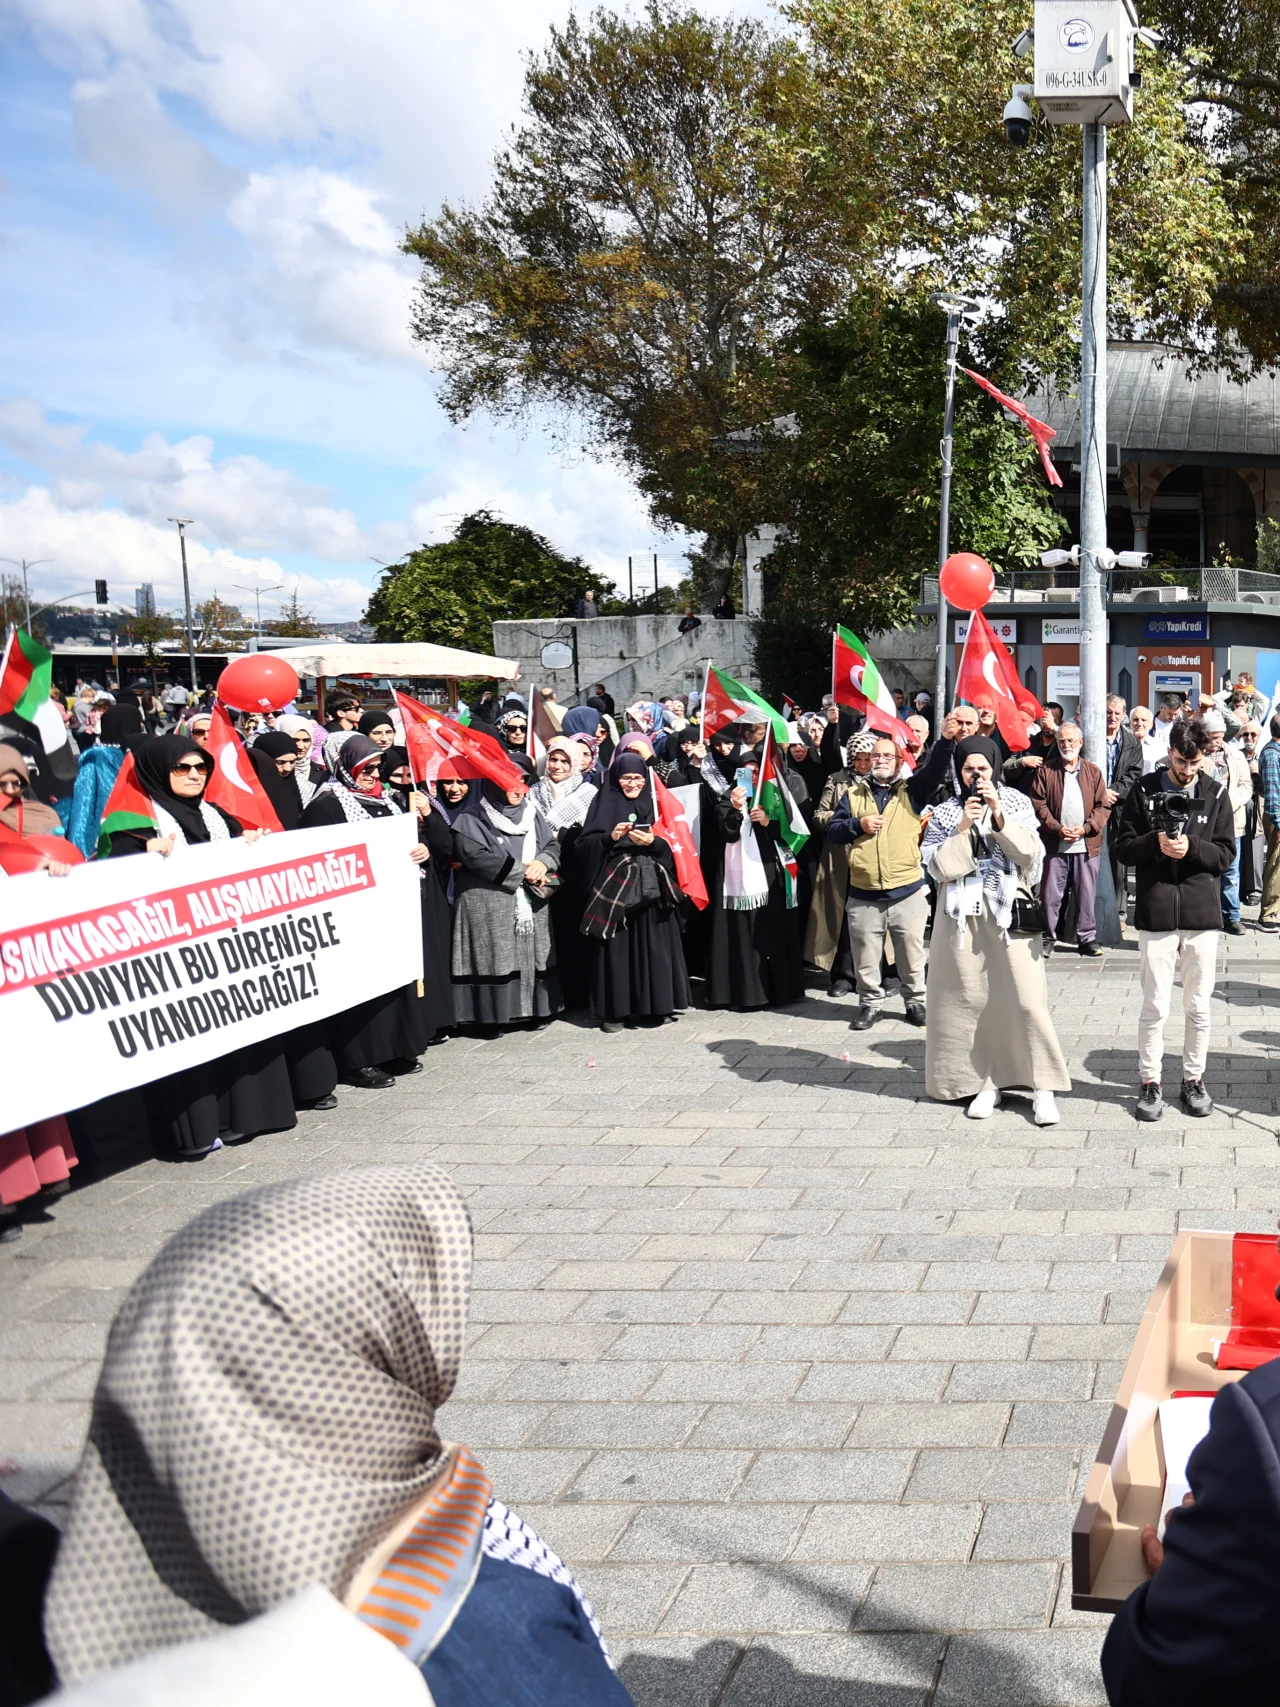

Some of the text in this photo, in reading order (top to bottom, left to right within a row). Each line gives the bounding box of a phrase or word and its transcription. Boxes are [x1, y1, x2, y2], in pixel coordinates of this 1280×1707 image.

[1045, 71, 1107, 88] 096-G-34USK-0
[1052, 625, 1080, 635] Garanti
[1167, 621, 1202, 633] YapıKredi
[1167, 655, 1200, 666] YapıKredi
[187, 852, 368, 926] ALIŞMAYACAĞIZ;
[34, 911, 341, 1022] DÜNYAYI BU DİRENİŞLE
[108, 962, 320, 1059] UYANDIRACAĞIZ!
